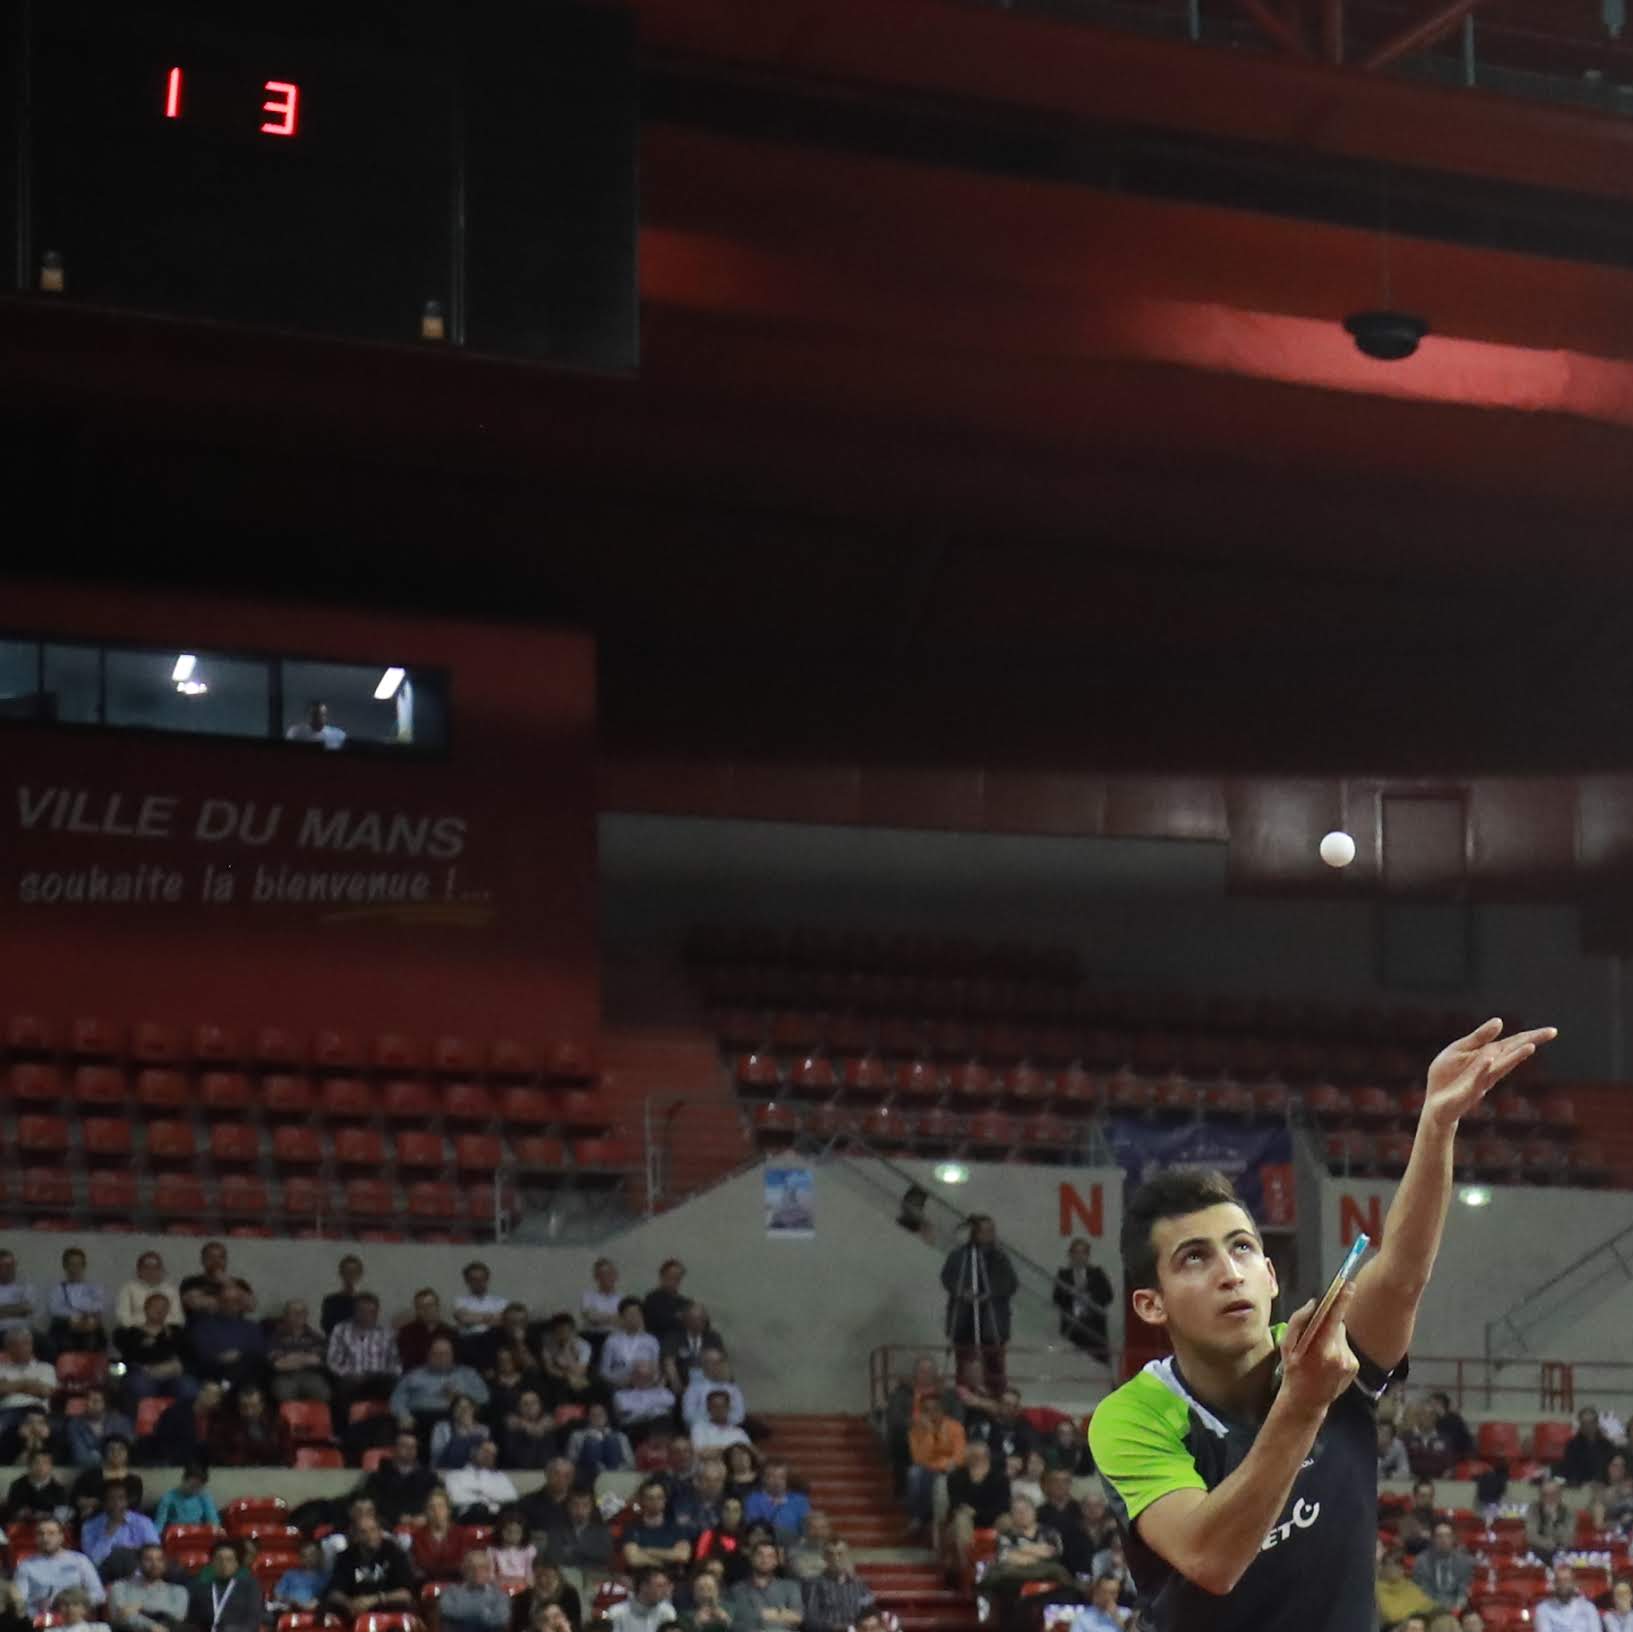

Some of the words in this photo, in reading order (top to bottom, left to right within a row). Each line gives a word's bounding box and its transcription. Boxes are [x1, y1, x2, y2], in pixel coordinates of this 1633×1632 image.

[165, 66, 181, 118] 1
[260, 80, 297, 136] 3
[17, 786, 178, 837] VILLE
[195, 799, 282, 846] DU
[298, 808, 467, 860] MANS
[18, 864, 185, 903] souhaite
[203, 865, 236, 901] la
[253, 864, 431, 902] bienvenue
[1059, 1182, 1104, 1238] N
[1339, 1194, 1382, 1250] N
